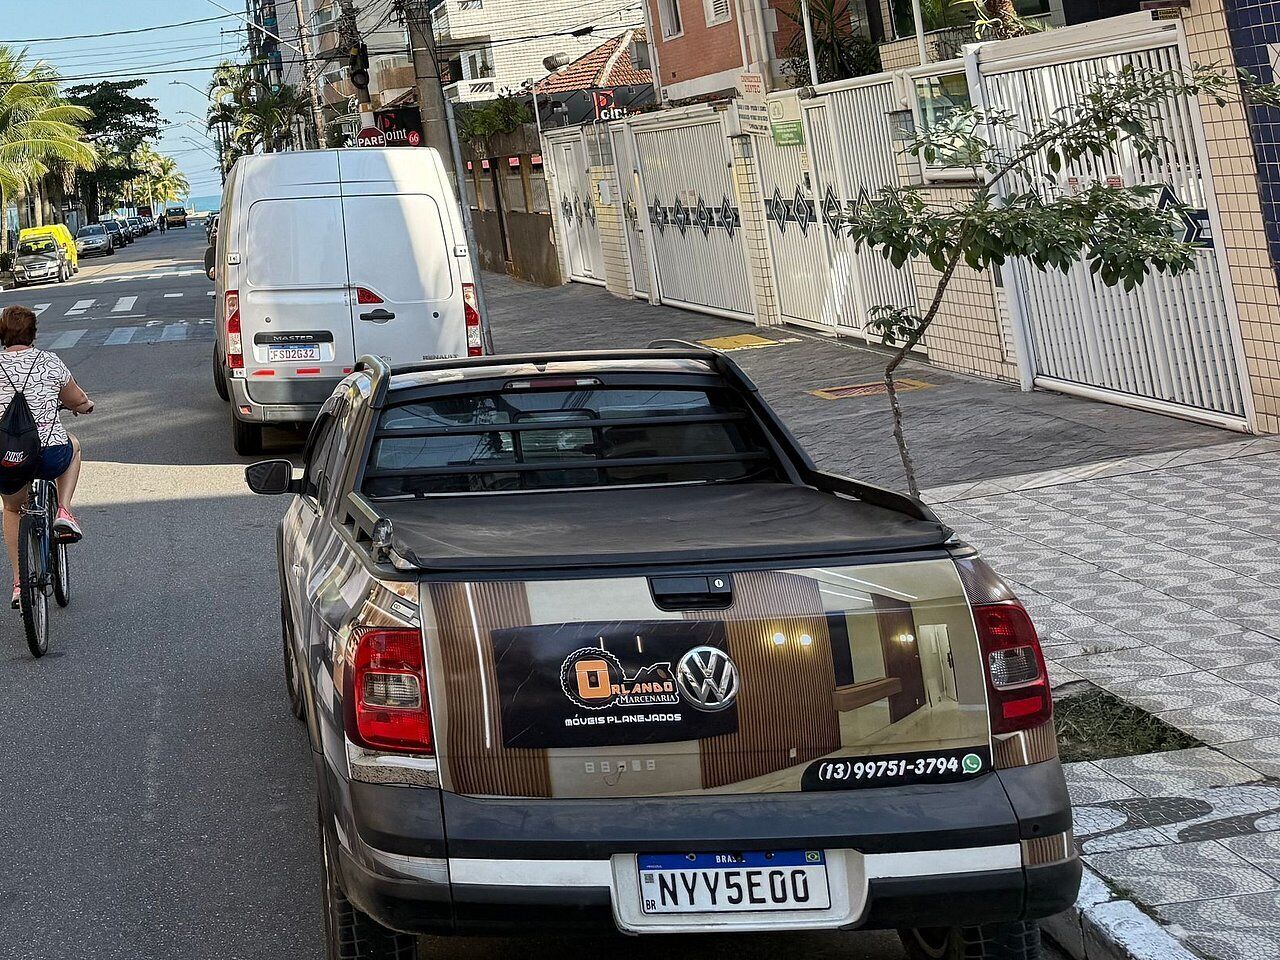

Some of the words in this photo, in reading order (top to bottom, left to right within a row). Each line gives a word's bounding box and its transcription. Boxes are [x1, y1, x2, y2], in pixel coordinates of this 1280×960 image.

[358, 135, 385, 147] PARE
[4, 450, 24, 463] NIKE
[606, 713, 682, 725] PLANEJADOS
[645, 899, 657, 911] BR
